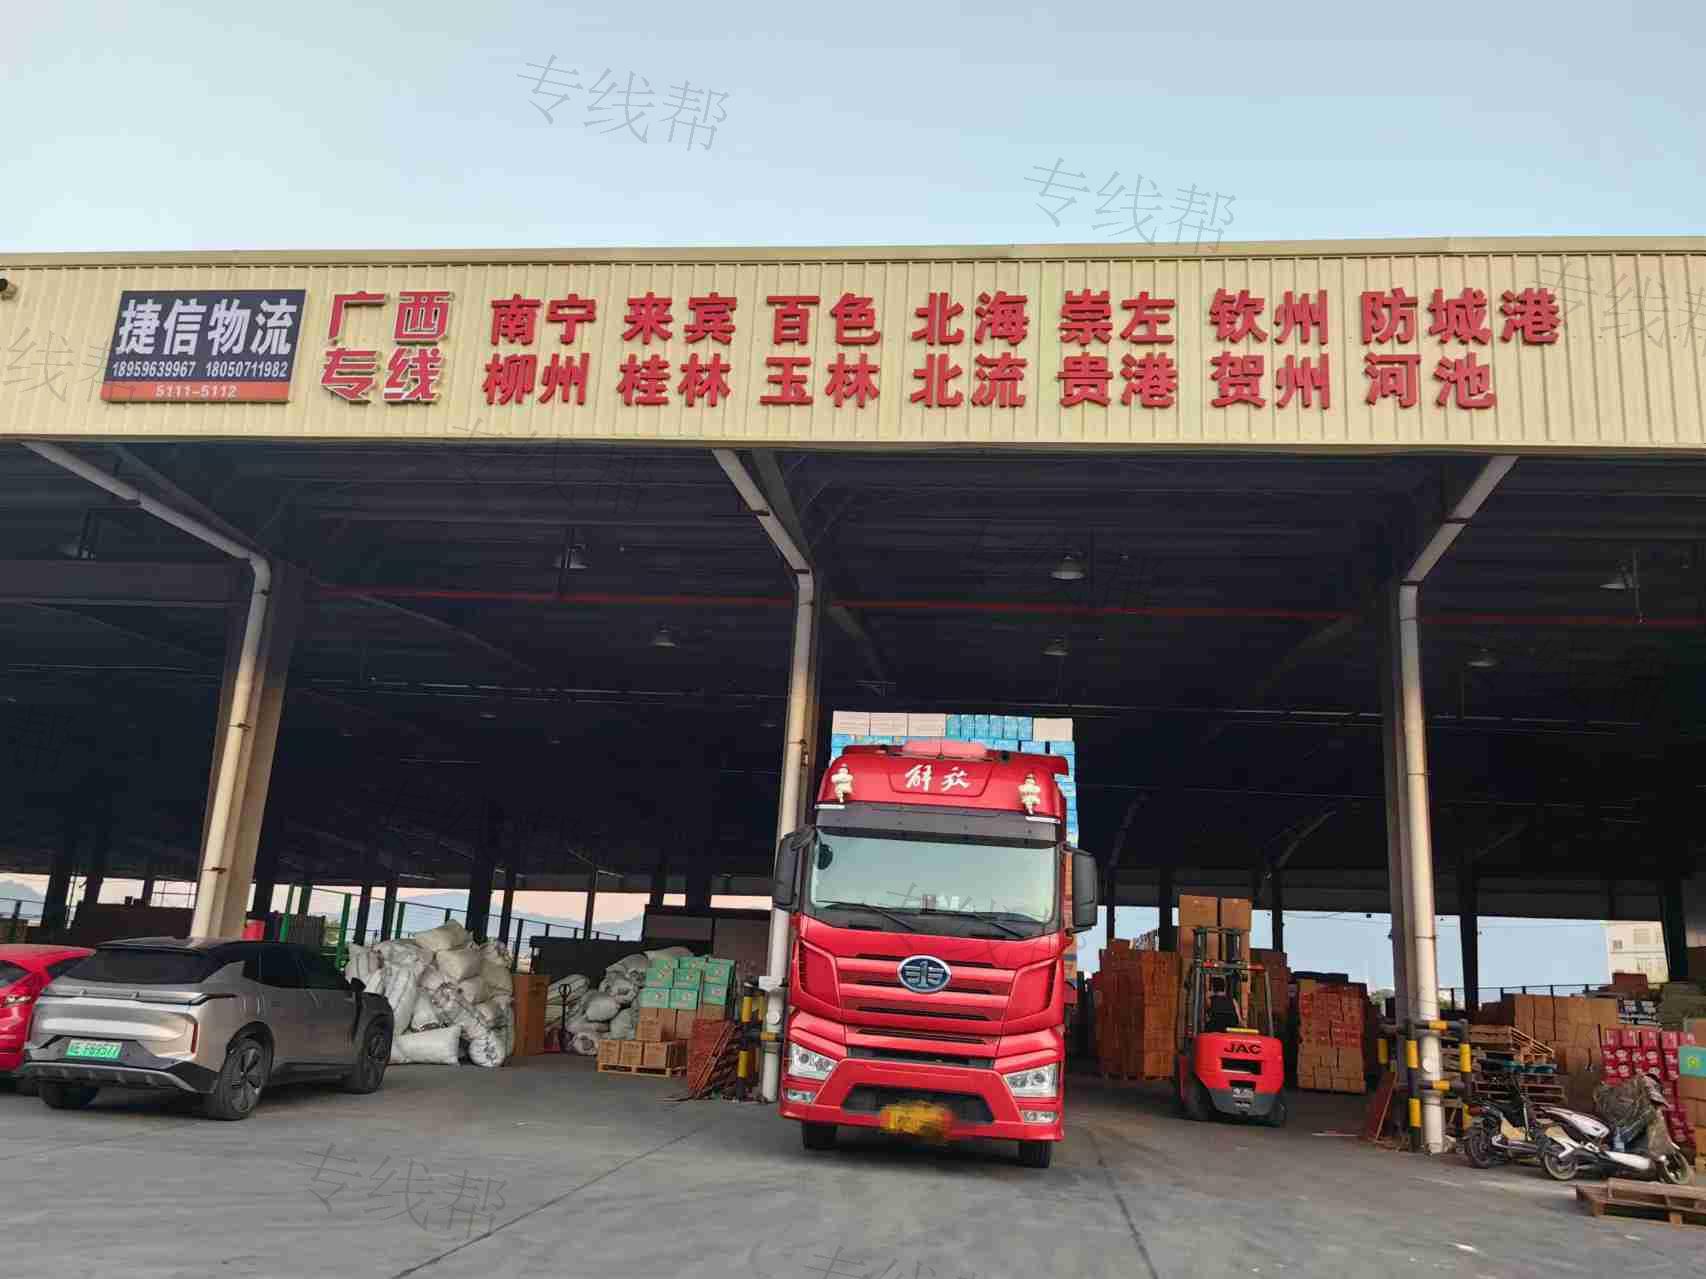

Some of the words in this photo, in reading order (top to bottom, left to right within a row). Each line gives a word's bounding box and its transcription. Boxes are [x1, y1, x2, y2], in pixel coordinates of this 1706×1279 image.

[115, 298, 298, 356] 捷信物流
[327, 290, 453, 343] 广西
[490, 292, 598, 346] 南宁
[623, 291, 738, 346] 来宾
[766, 292, 882, 346] 百色
[911, 290, 1030, 347] 北海
[1056, 287, 1178, 346] 崇左
[1209, 287, 1330, 346] 钦州
[1359, 287, 1564, 346] 防城港
[112, 360, 196, 377] 18959639967
[206, 360, 289, 377] 18050711982
[156, 384, 239, 399] 5111-5112
[320, 347, 446, 402] 专线
[481, 351, 592, 407] 柳州
[616, 351, 734, 407] 桂林
[758, 352, 882, 409] 玉林
[911, 351, 1030, 408] 北流
[1056, 351, 1179, 408] 贵港
[1208, 351, 1332, 410] 贺州
[1364, 351, 1499, 411] 河池
[1223, 1042, 1263, 1055] JAC
